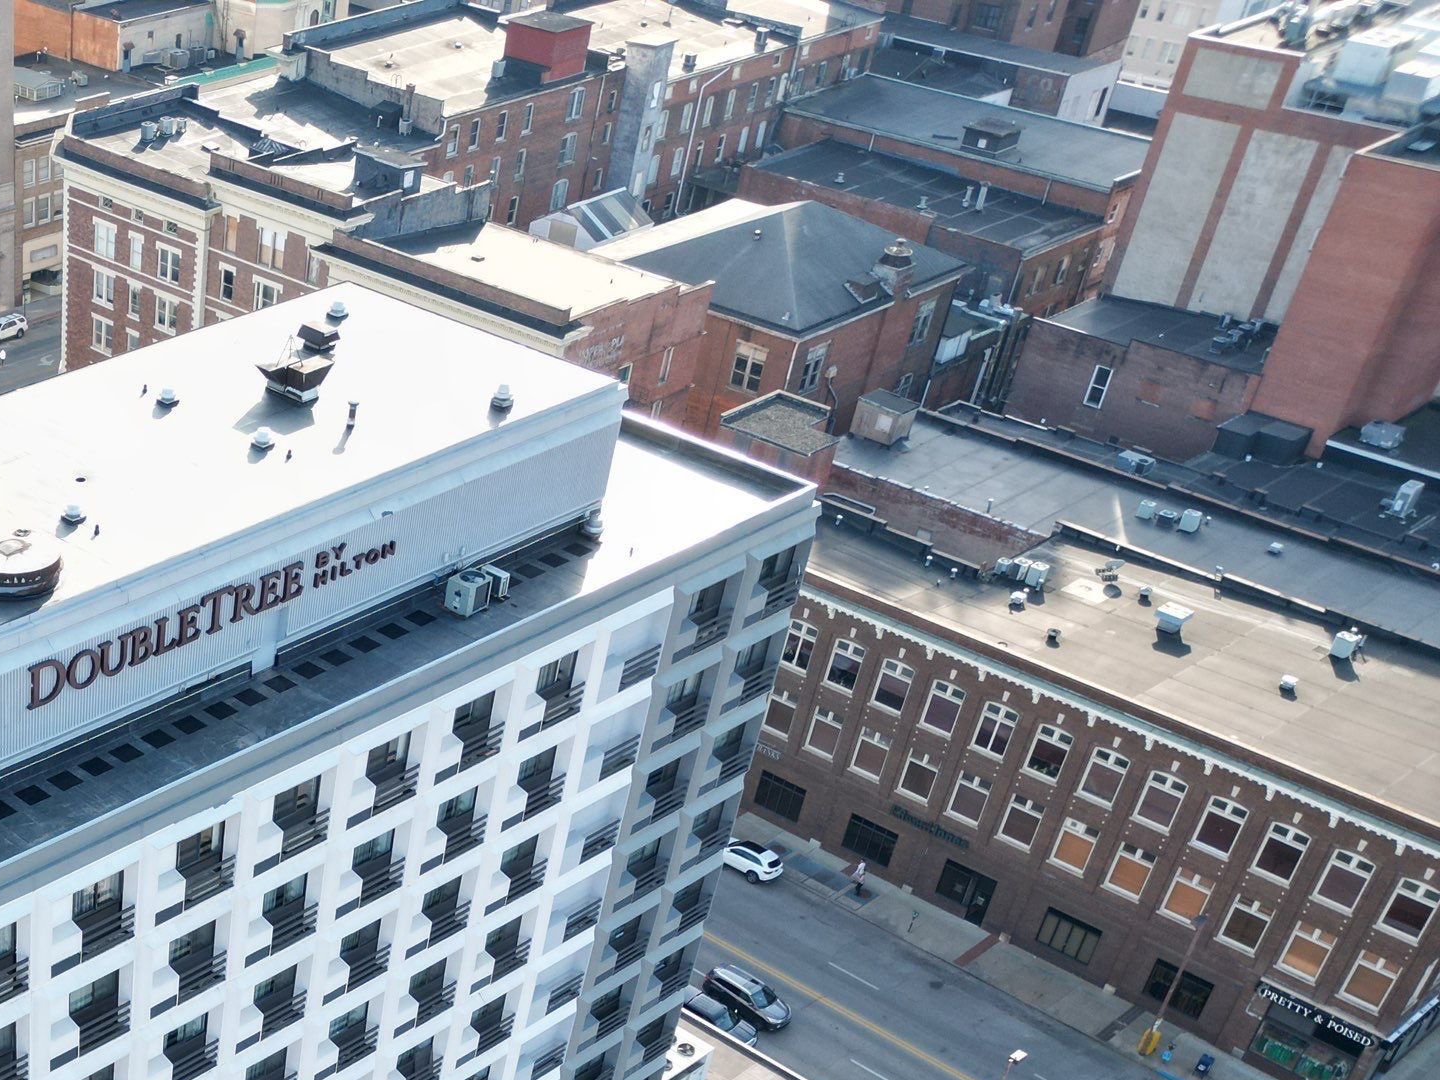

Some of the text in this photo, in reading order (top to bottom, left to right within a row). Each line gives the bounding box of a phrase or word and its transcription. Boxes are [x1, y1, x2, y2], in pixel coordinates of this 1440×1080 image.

[315, 542, 347, 569] BY
[26, 540, 397, 711] DOUBLETREE HILTON
[1261, 988, 1372, 1047] PRETTY & POISED
